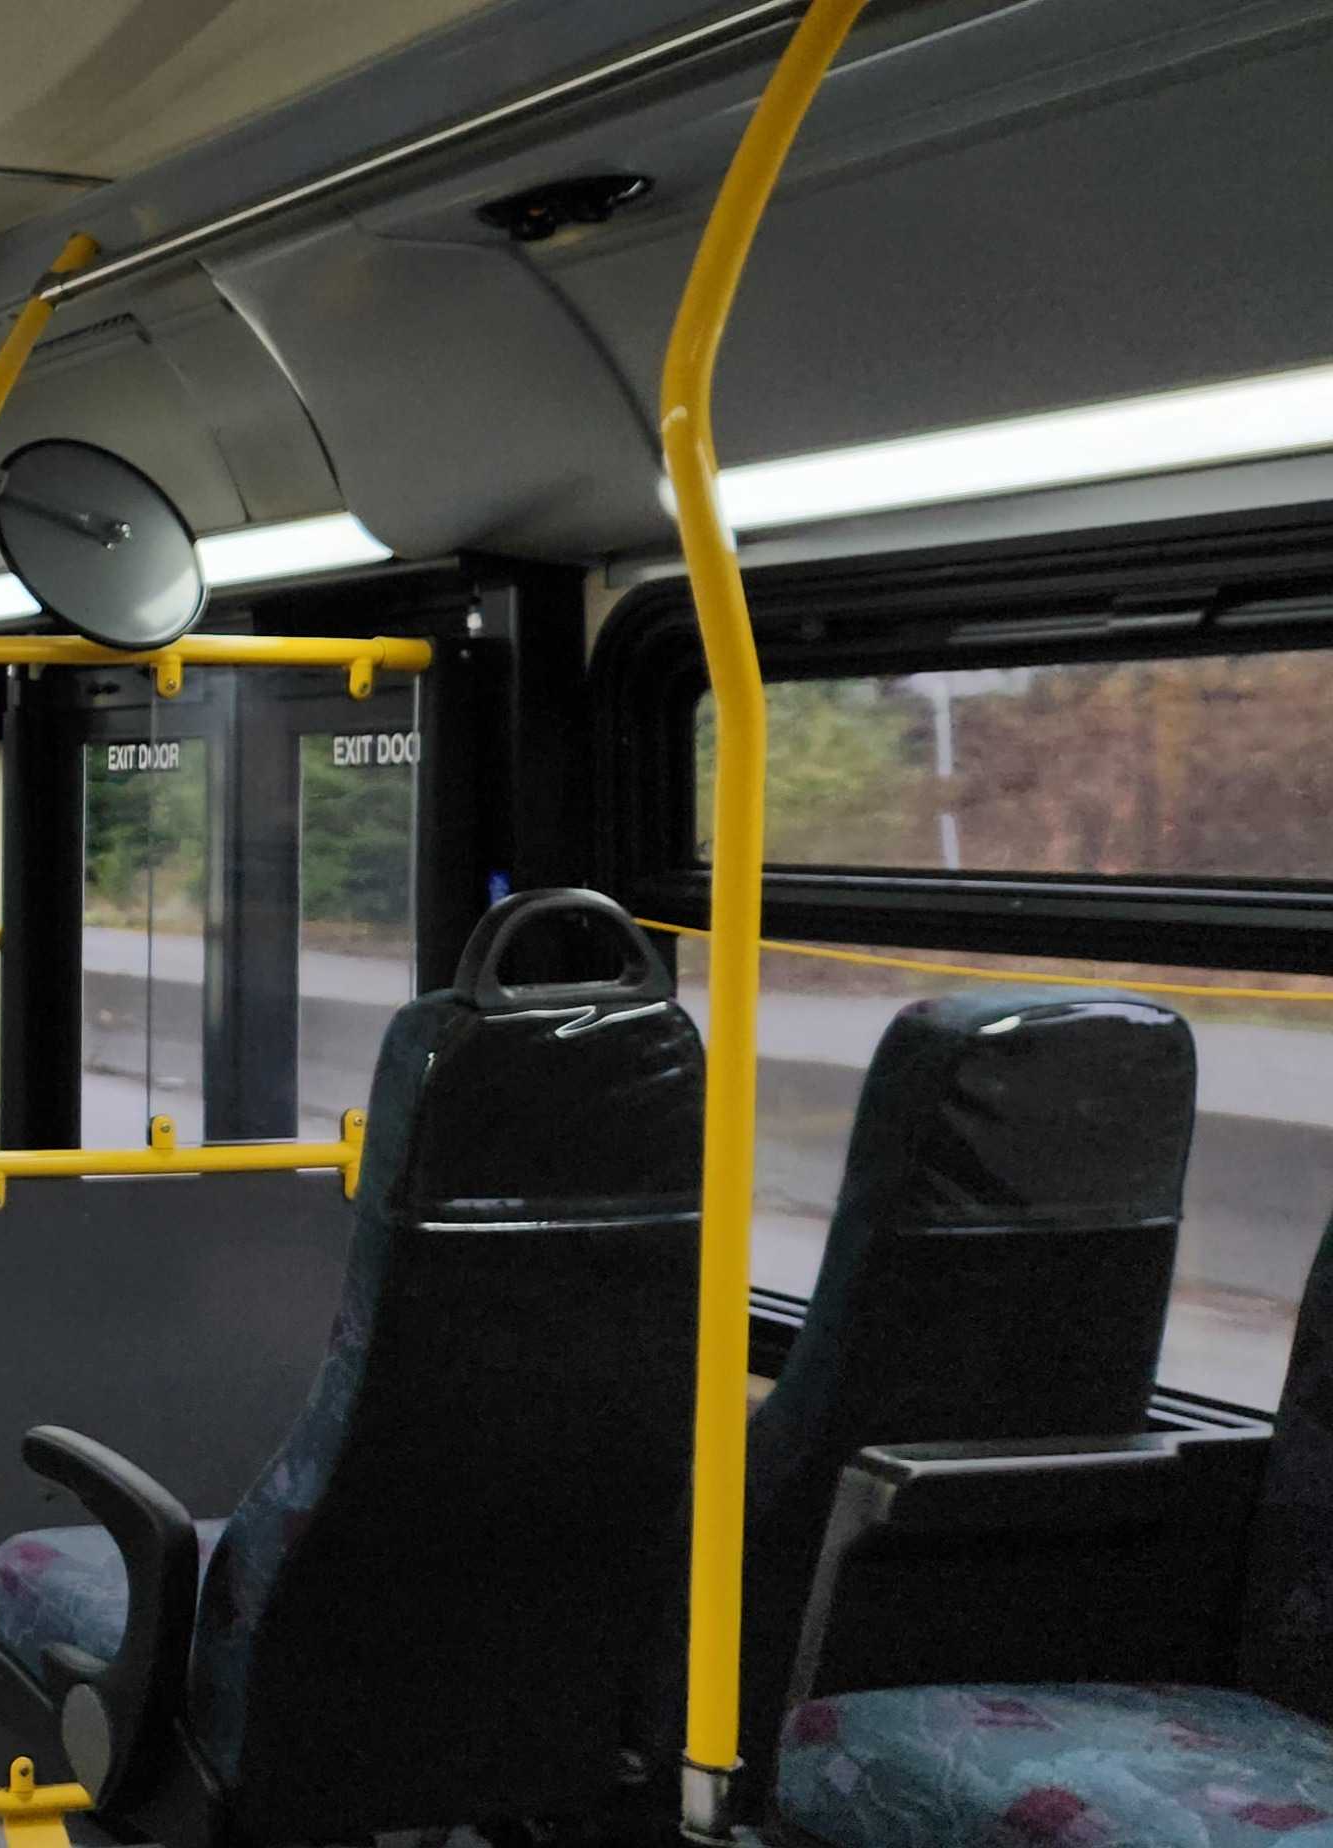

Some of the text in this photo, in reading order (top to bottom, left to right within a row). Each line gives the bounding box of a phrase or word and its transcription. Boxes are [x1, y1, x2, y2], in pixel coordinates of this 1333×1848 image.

[108, 742, 179, 771] EXIT DOOR
[334, 731, 421, 765] EXIT DOO
